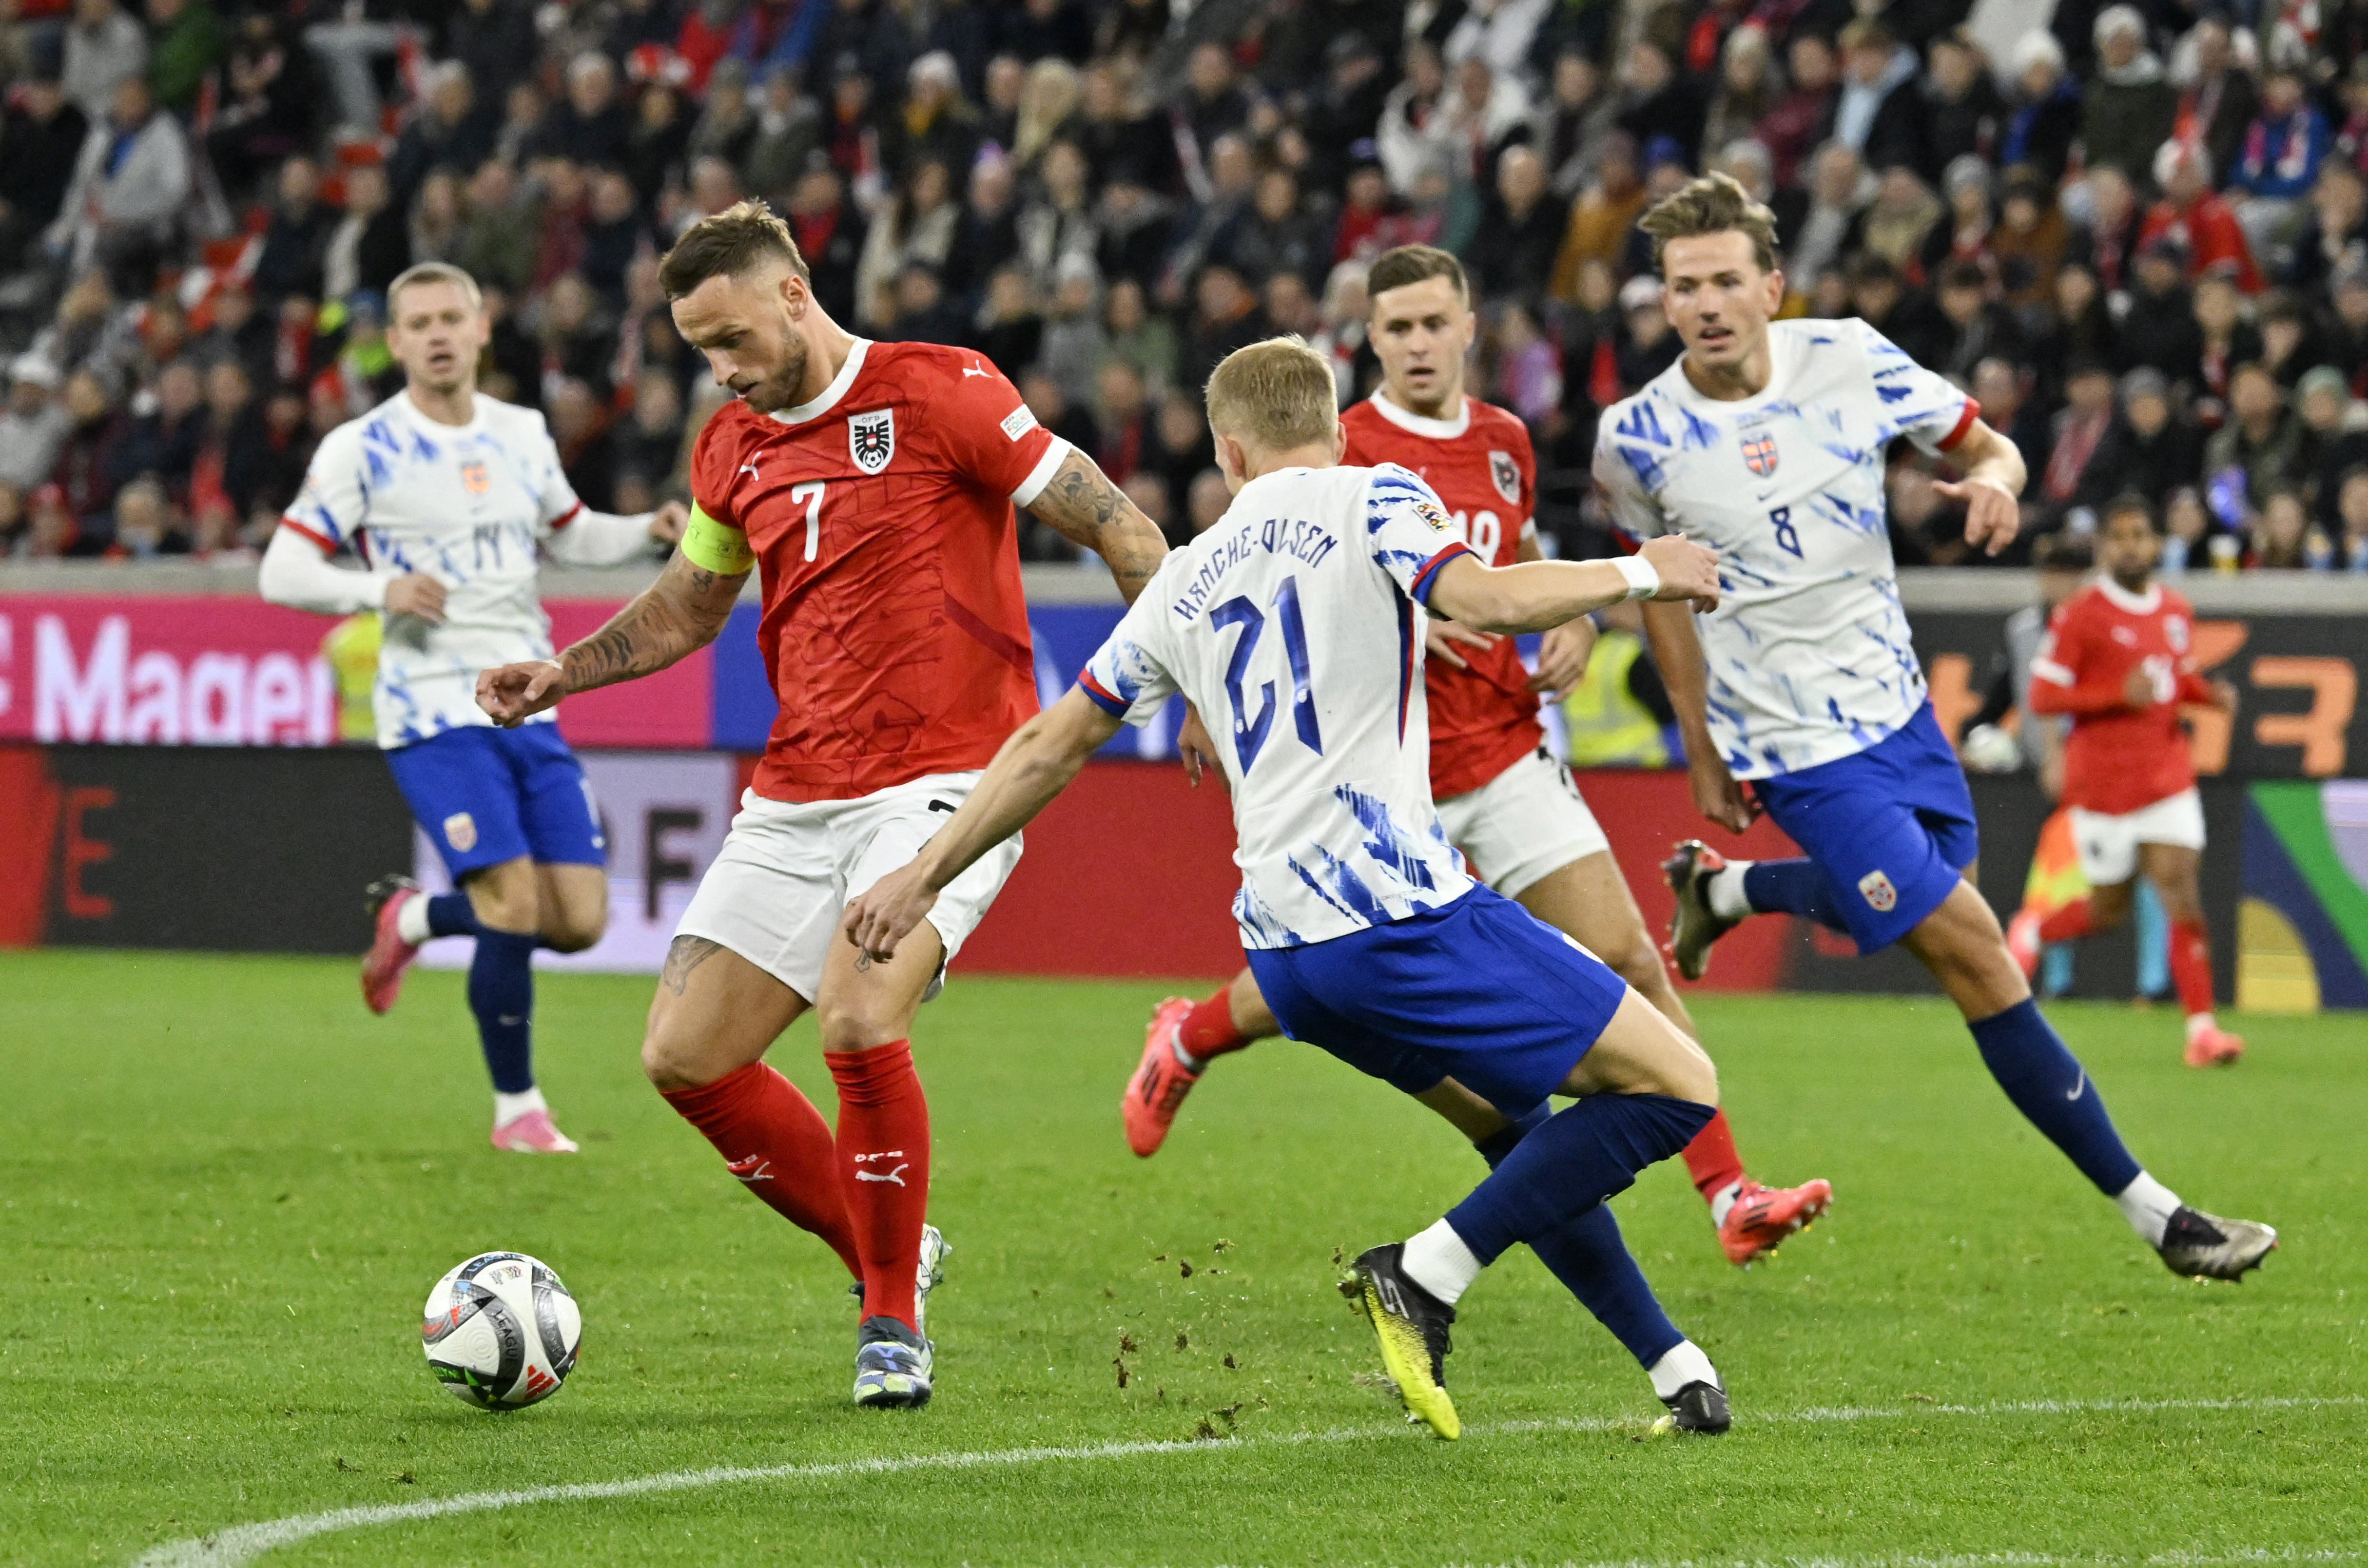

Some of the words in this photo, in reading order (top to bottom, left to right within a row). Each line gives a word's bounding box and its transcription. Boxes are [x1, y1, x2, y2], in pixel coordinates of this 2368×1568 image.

[791, 479, 826, 562] 7
[1769, 505, 1804, 559] 8
[1173, 519, 1338, 621] HANCHE-OLSEN
[1209, 575, 1323, 779] 21
